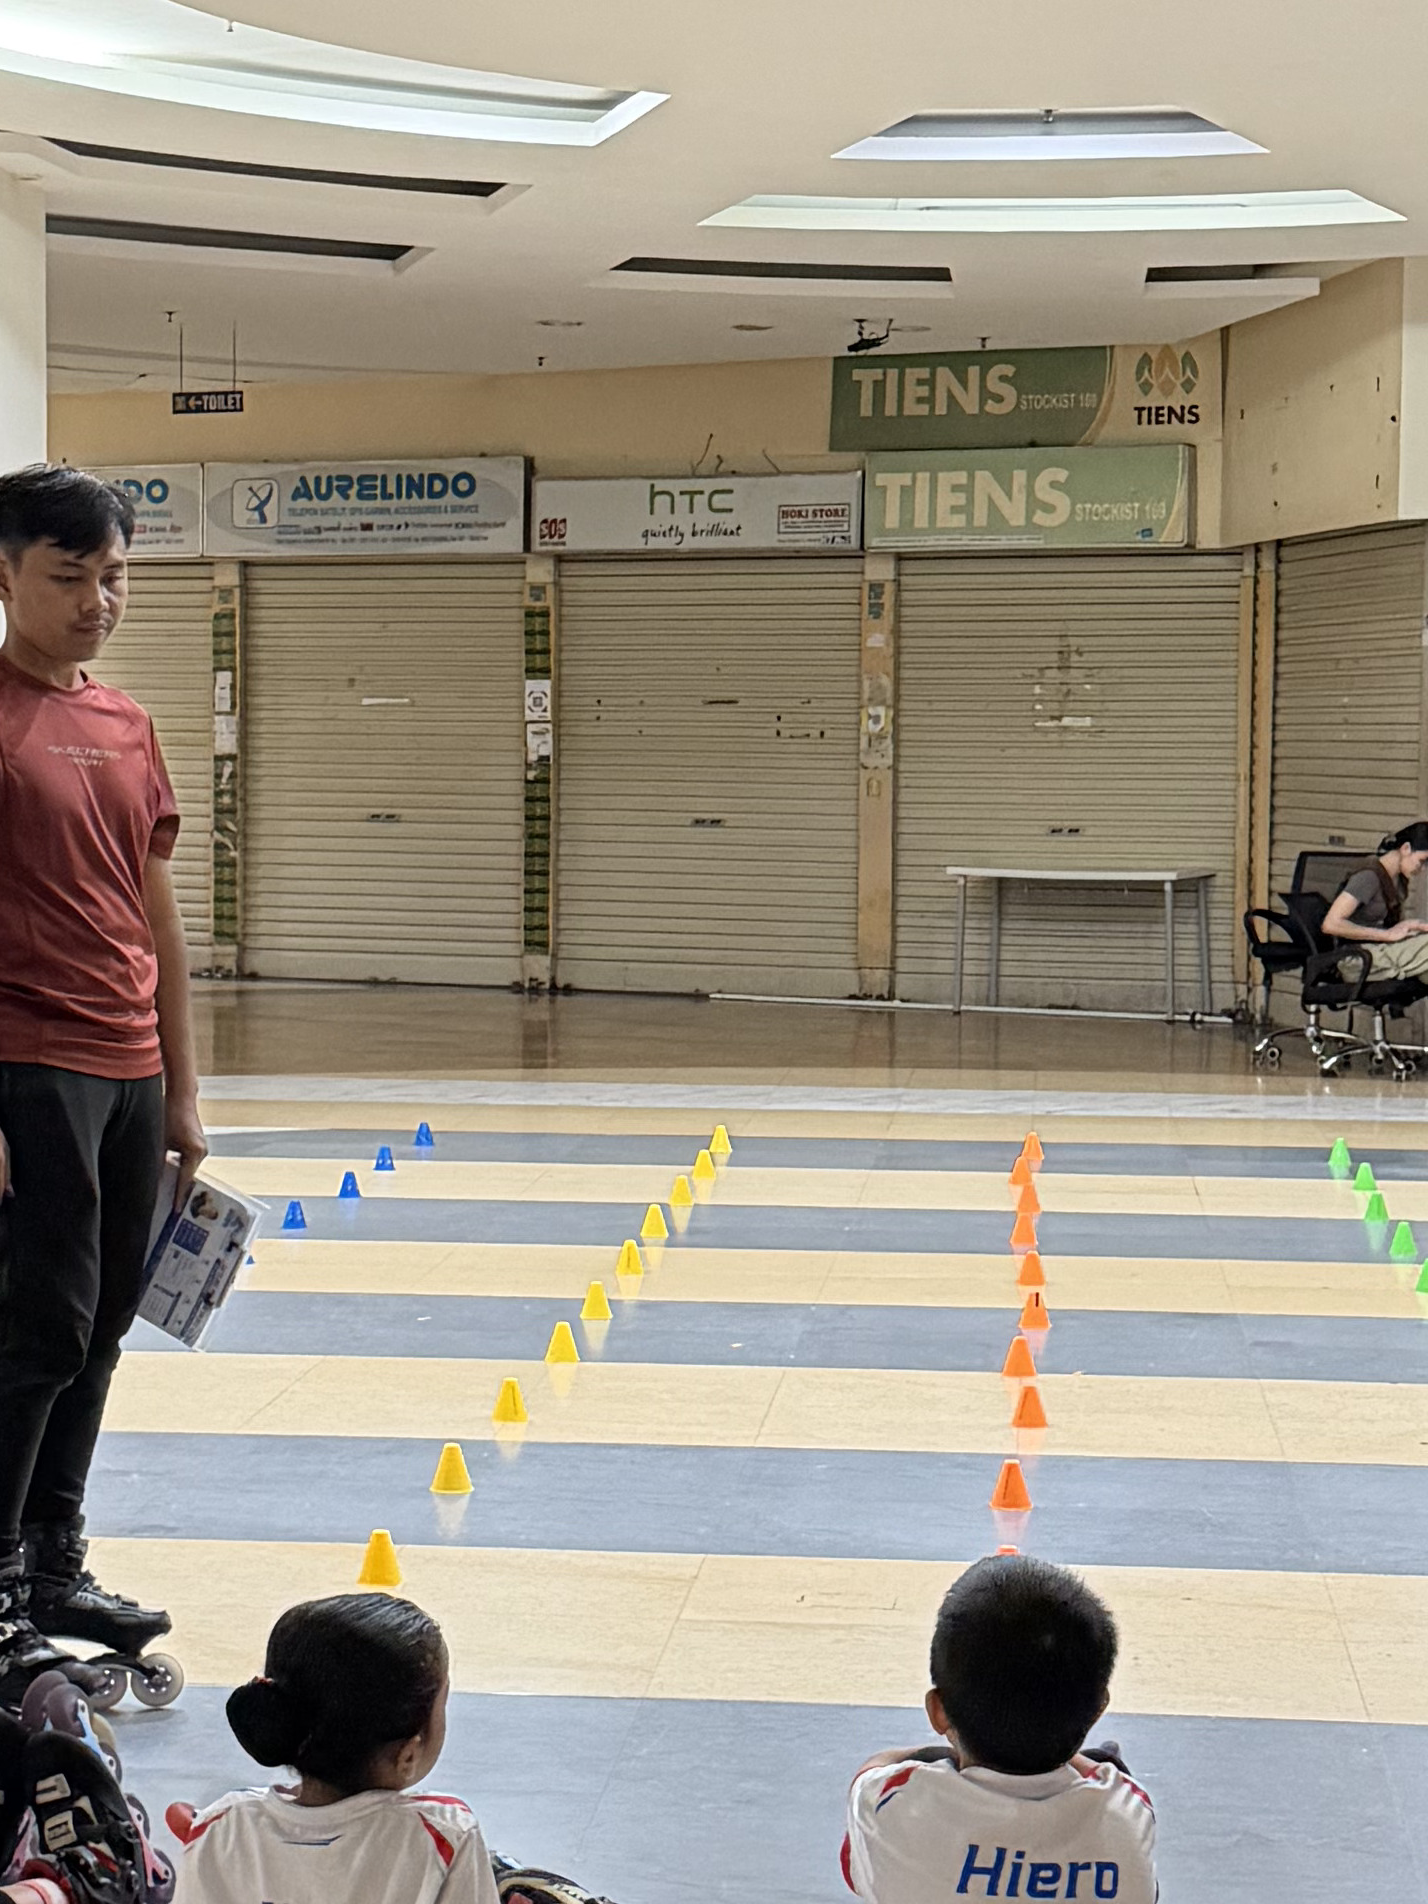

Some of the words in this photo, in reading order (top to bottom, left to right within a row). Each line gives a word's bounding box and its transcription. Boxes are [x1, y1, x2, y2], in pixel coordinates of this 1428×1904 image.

[852, 363, 1018, 417] TIENS
[203, 393, 242, 411] TOILET
[1019, 393, 1076, 411] STOCKIST
[1133, 404, 1201, 426] TIENS
[290, 471, 477, 502] AURELINDO
[875, 467, 1071, 529] TIENS
[811, 507, 848, 519] STORE
[1074, 502, 1141, 522] STOCKIST
[539, 518, 567, 539] SOS
[641, 523, 685, 546] quietly
[691, 521, 742, 538] brilliant
[956, 1844, 1119, 1899] Hiero
